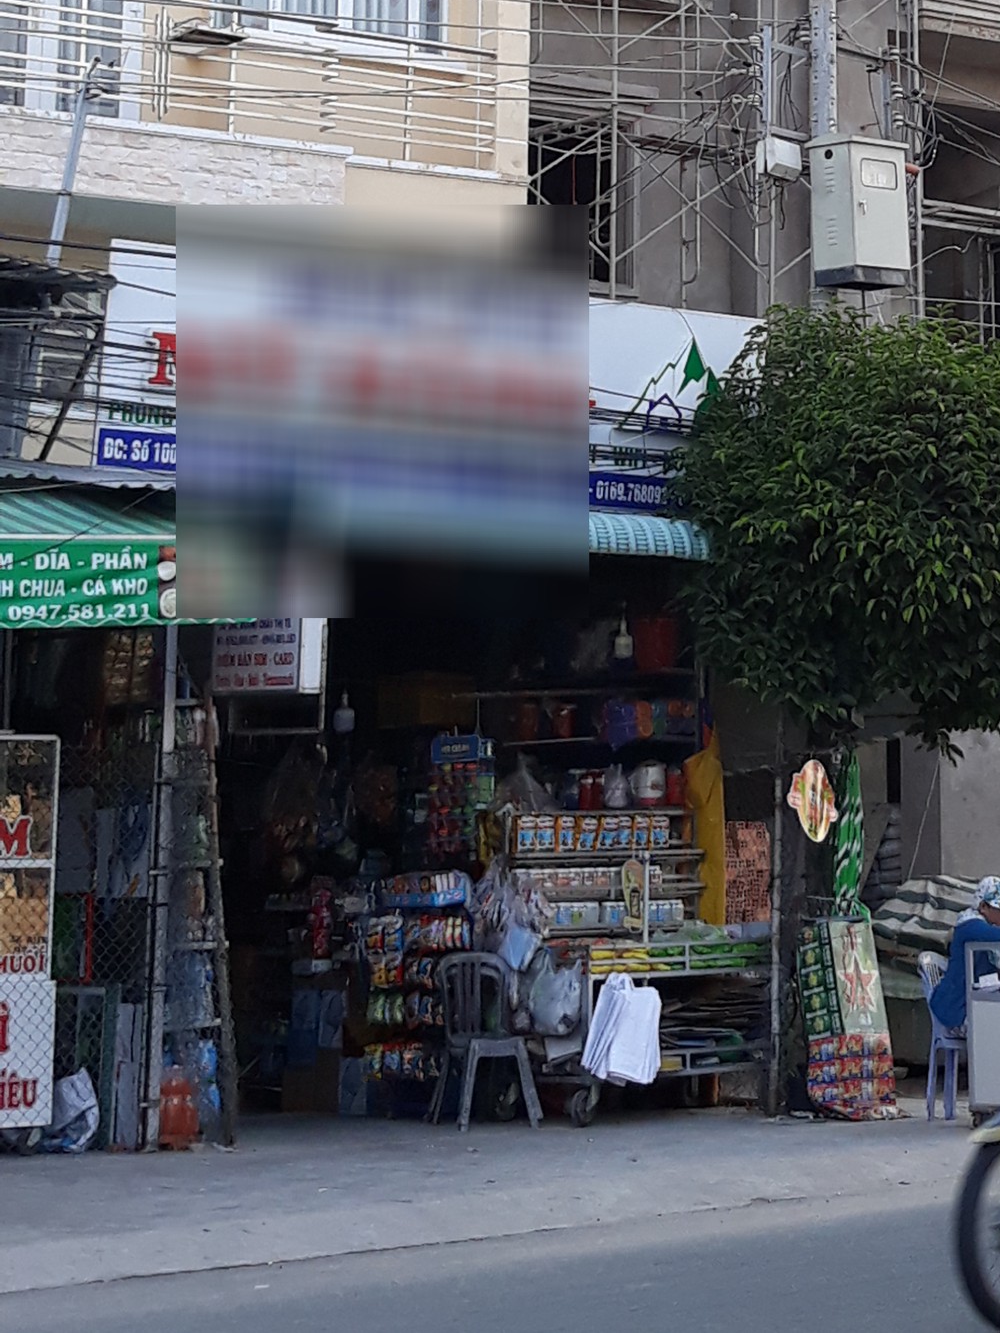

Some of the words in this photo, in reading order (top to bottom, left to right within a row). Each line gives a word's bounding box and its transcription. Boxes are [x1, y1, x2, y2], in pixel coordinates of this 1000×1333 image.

[91, 546, 148, 570] PHẦN
[19, 578, 66, 597] CHUA
[82, 575, 107, 596] CÁ
[111, 578, 148, 596] KHO
[8, 603, 149, 621] 0947.581.211
